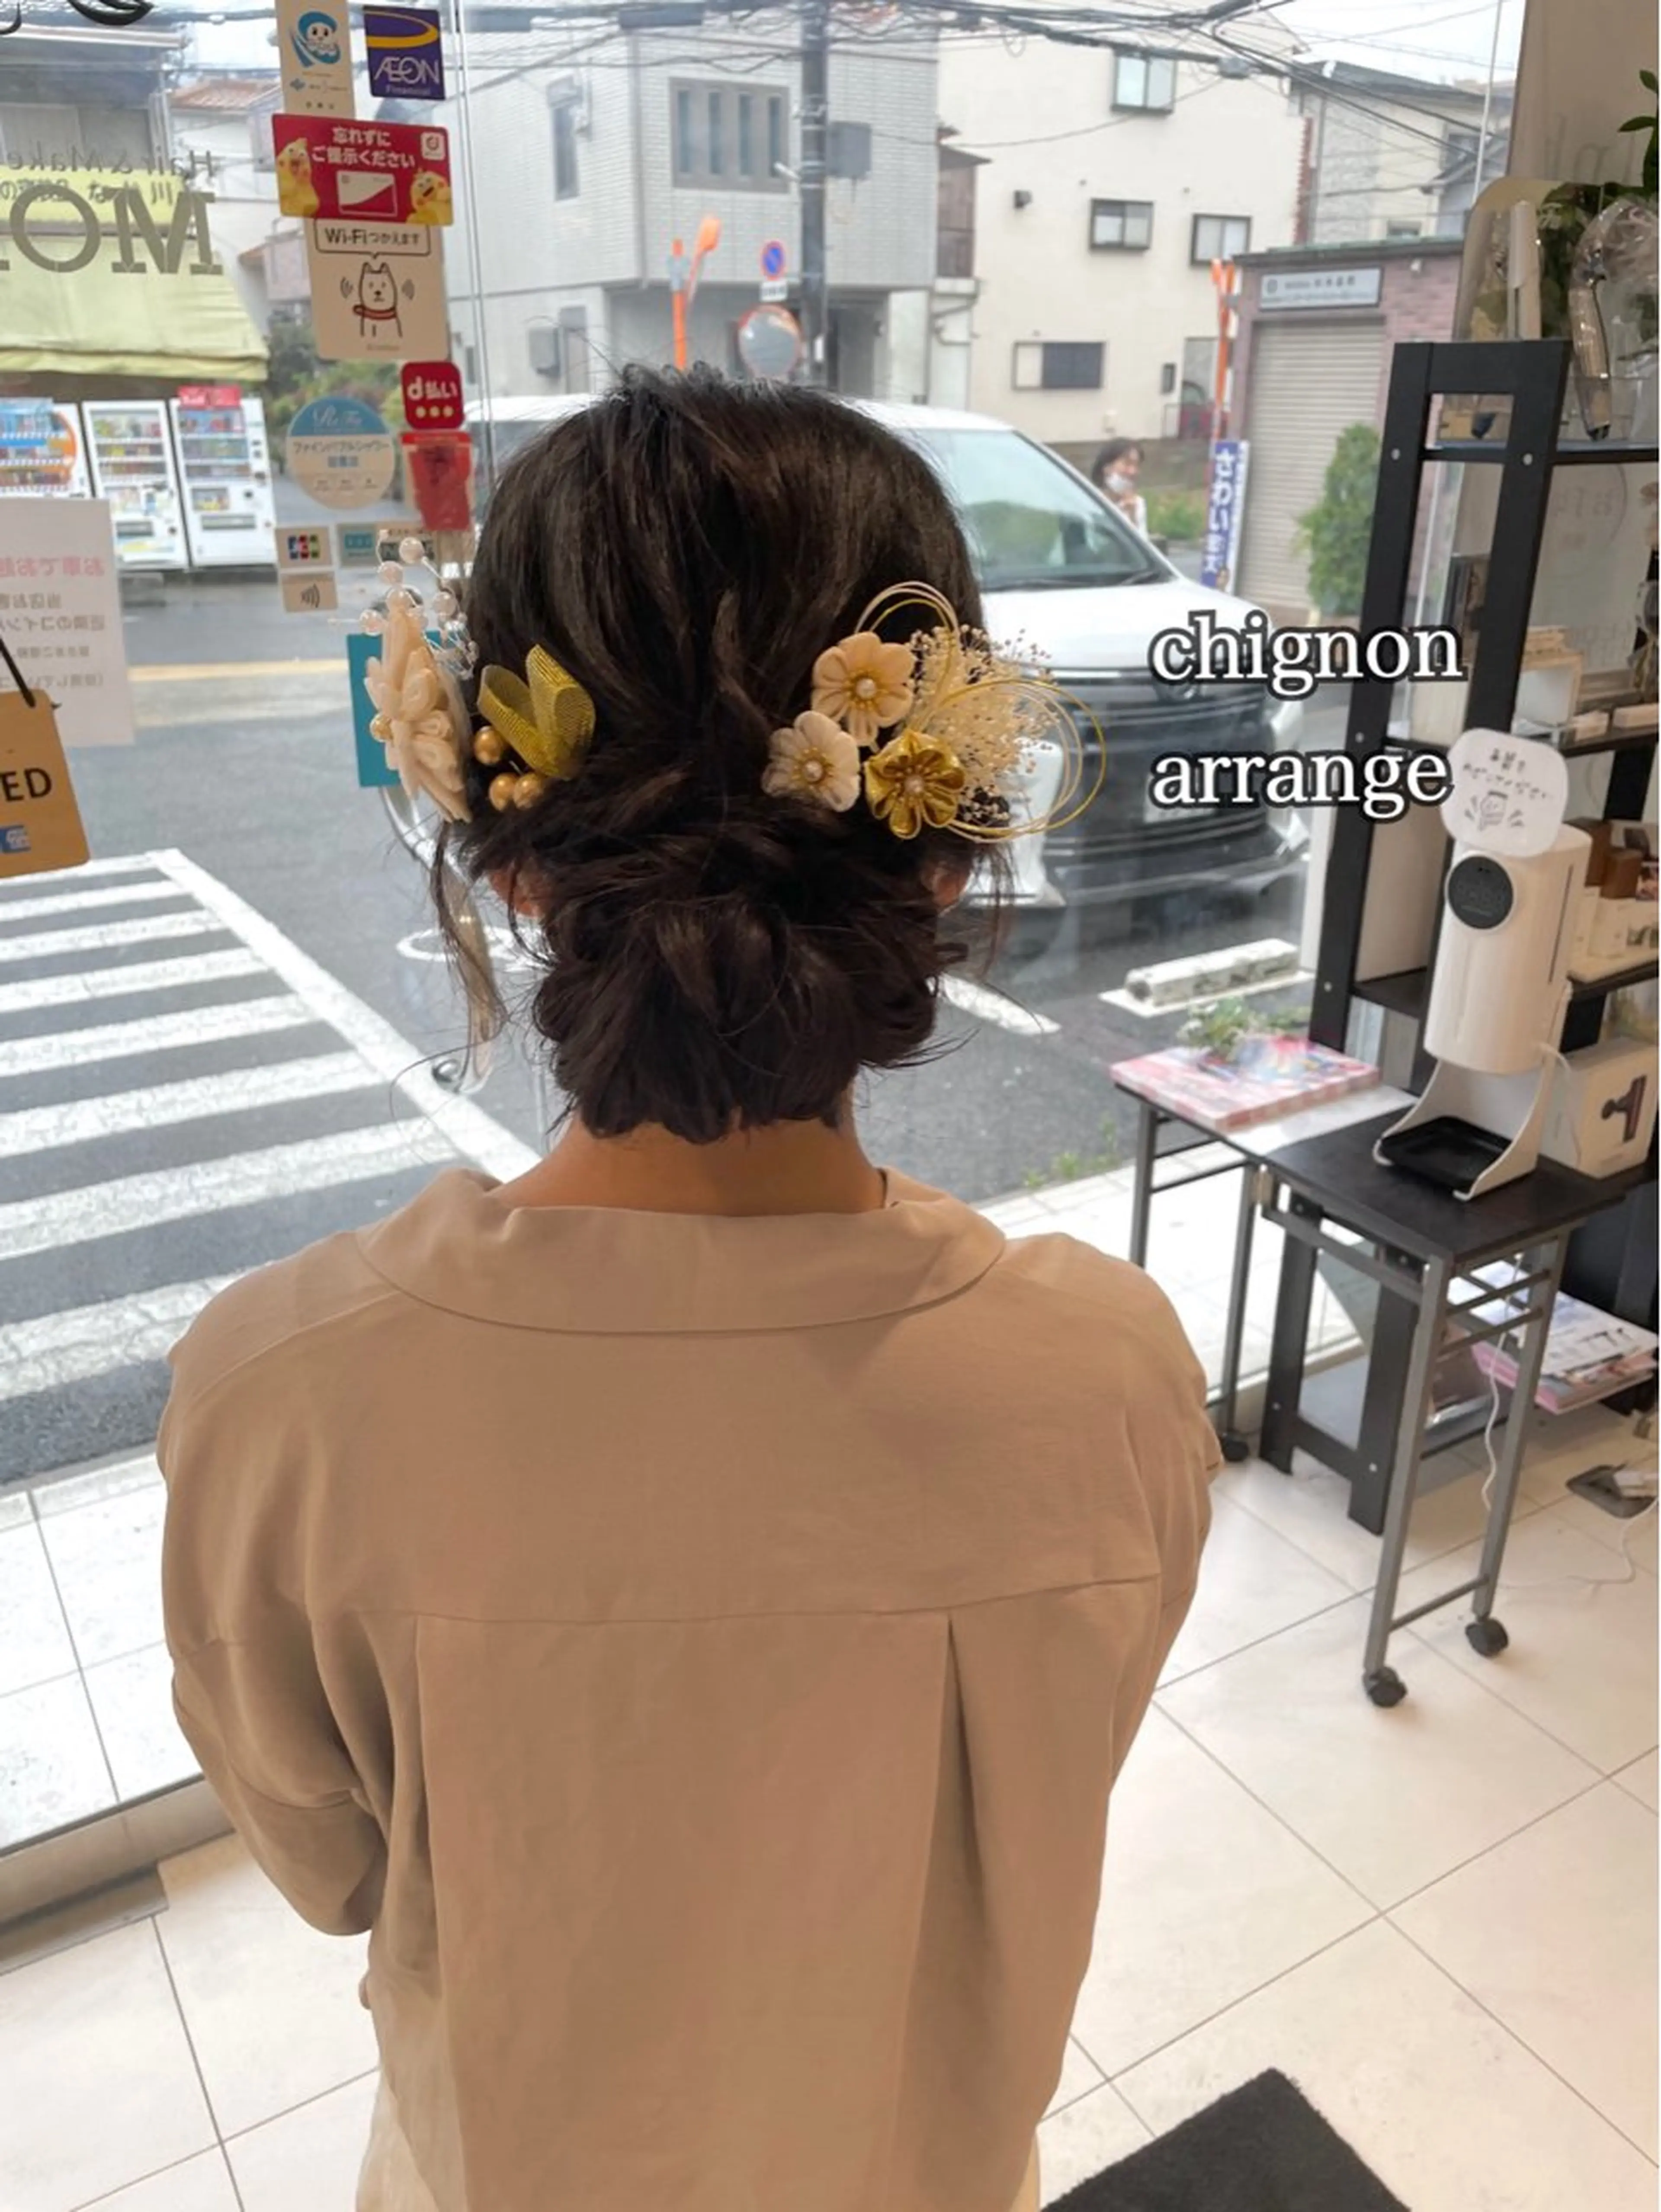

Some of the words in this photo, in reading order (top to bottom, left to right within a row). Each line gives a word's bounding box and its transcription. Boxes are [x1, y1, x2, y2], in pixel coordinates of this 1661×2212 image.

[332, 127, 391, 147] 忘れずに
[311, 145, 415, 169] ご提示ください
[0, 768, 52, 801] ED
